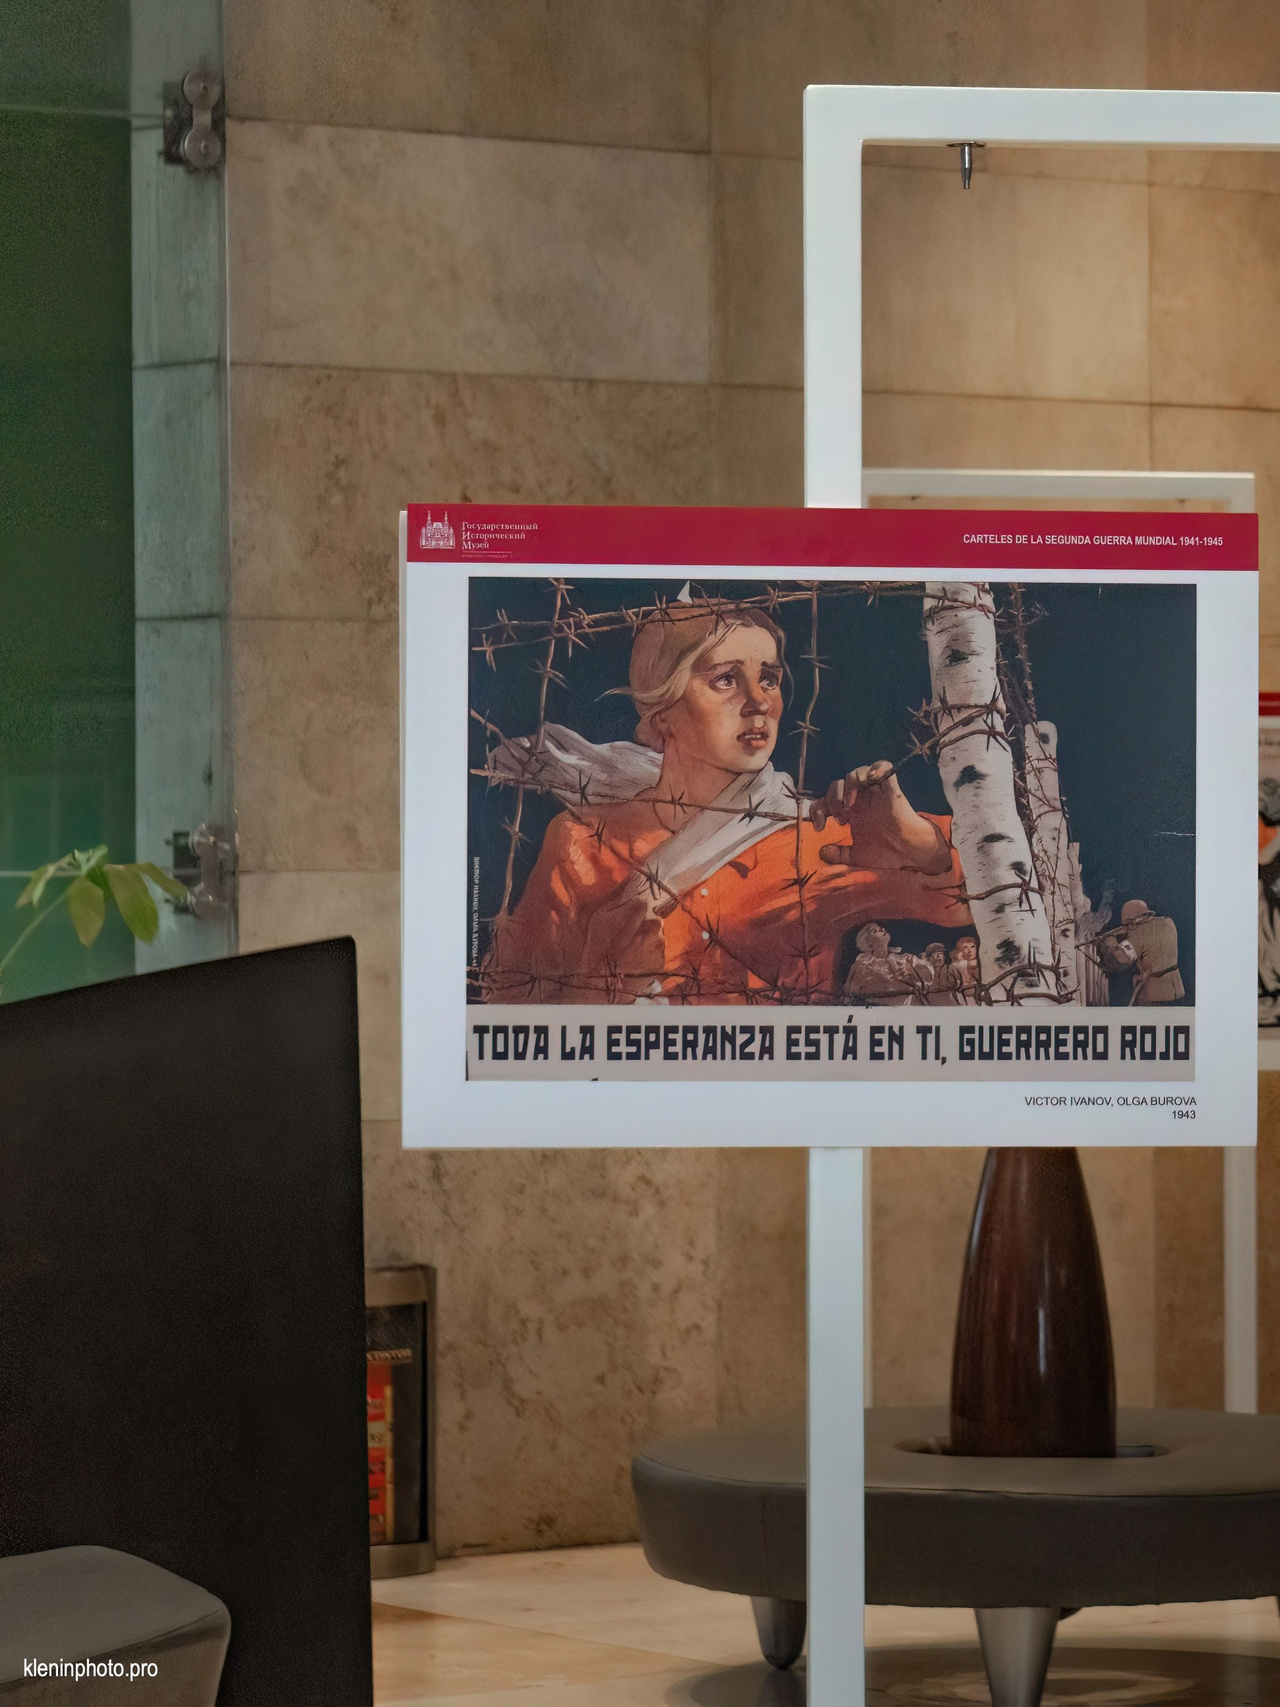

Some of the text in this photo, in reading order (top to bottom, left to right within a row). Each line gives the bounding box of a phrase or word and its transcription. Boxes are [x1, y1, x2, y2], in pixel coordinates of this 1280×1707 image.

[462, 521, 538, 530] Государственный
[462, 531, 526, 540] Исторический
[963, 534, 1223, 546] CARTELES DE LA SEGUNDA GUERRA MUNDIAL 1941-1945
[462, 540, 489, 550] Музей
[473, 1014, 1190, 1066] TODA LA ESPERANZA ESTÁ EN TI, GUERRERO ROJO
[1024, 1096, 1197, 1108] VICTOR IVANOV, OLGA BUROVA
[1172, 1110, 1196, 1120] 1943
